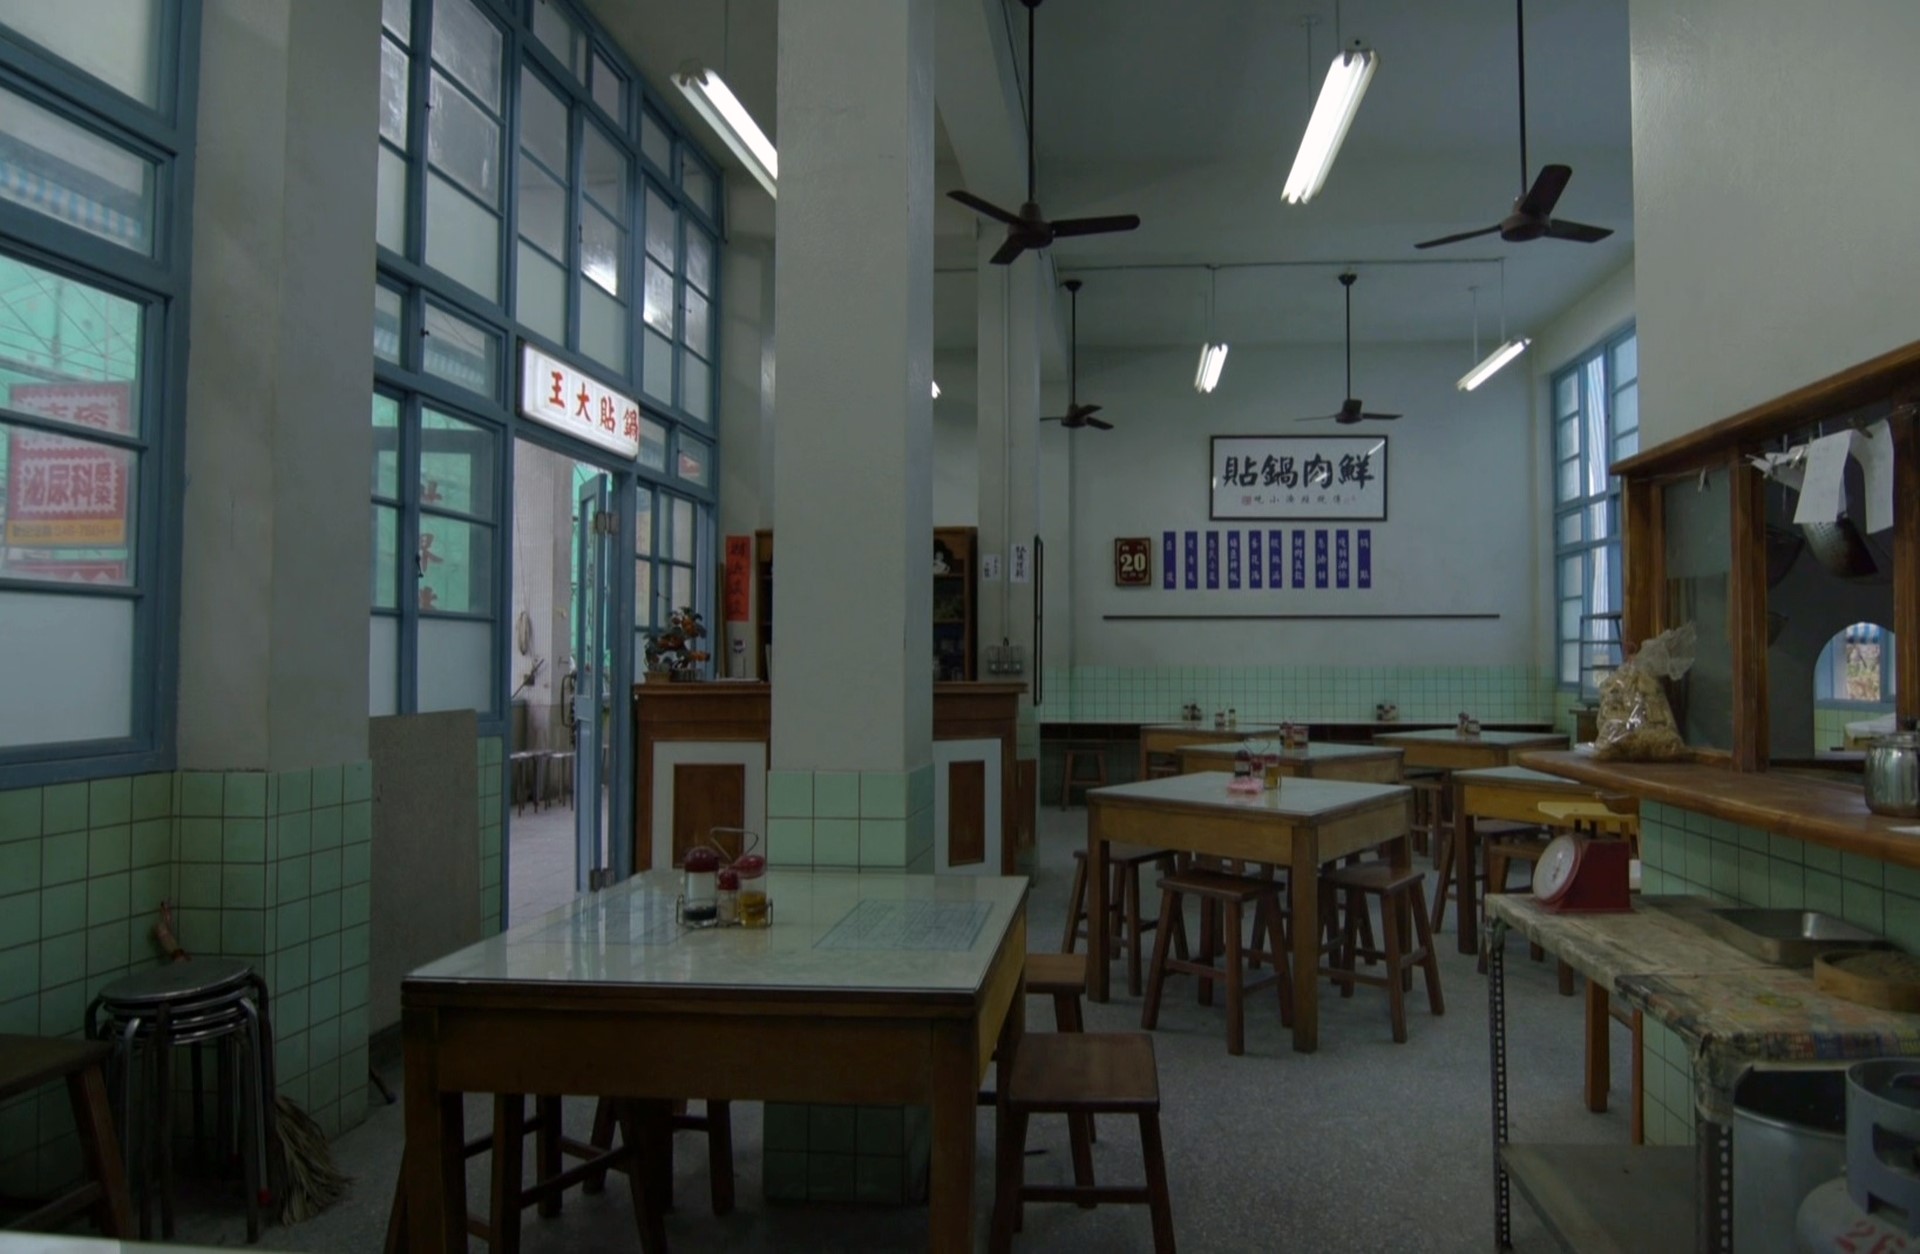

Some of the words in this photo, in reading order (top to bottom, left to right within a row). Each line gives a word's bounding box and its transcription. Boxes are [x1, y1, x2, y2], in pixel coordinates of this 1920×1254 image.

[1222, 453, 1375, 490] 鮮肉鍋貼
[1119, 552, 1146, 572] 20
